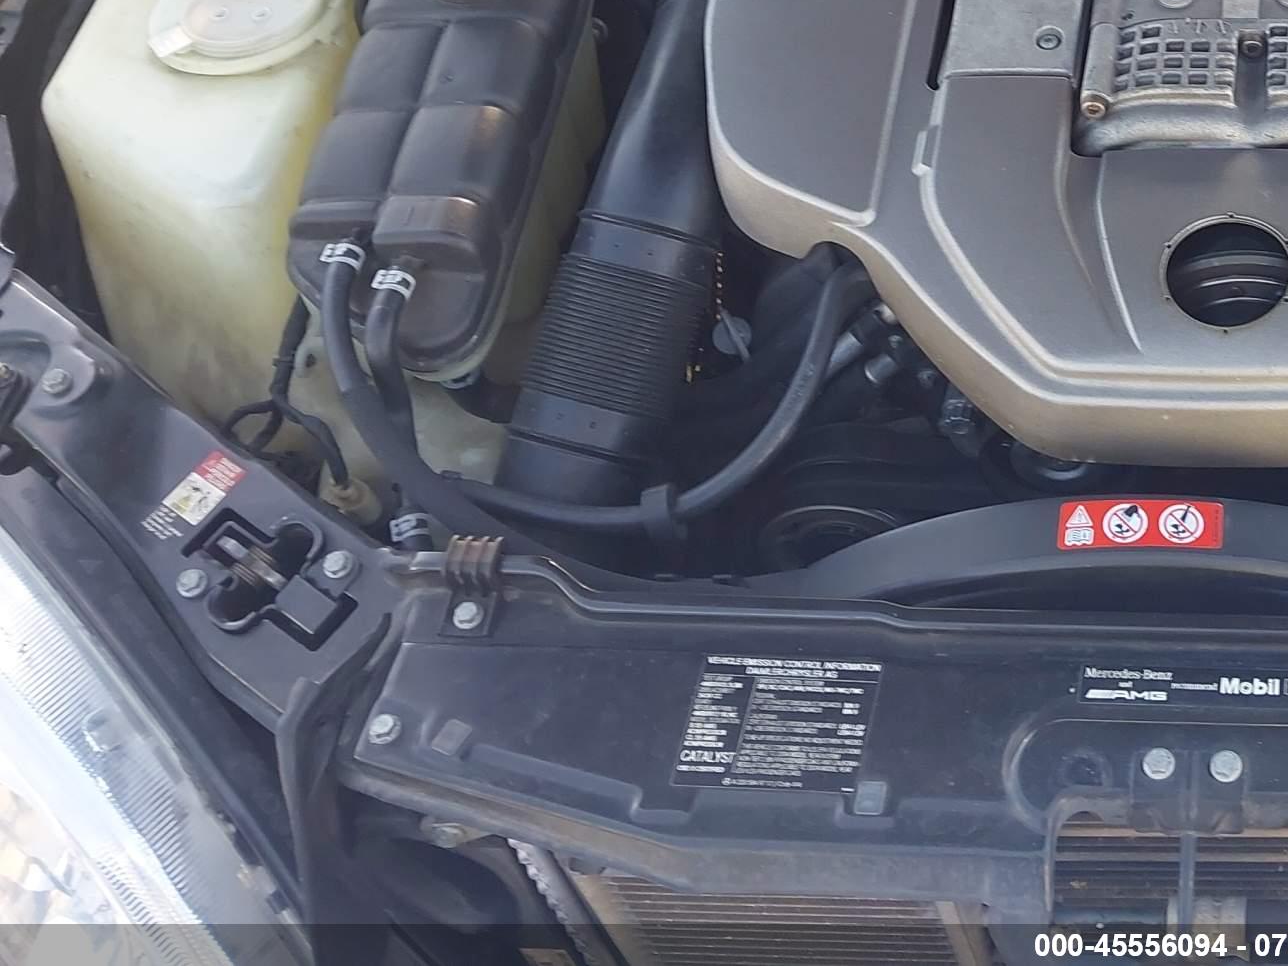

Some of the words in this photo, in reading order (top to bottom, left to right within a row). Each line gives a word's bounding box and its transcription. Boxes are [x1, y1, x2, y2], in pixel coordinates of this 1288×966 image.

[707, 656, 742, 666] VEHICLE
[742, 657, 783, 667] EMISSION
[784, 660, 822, 669] CONTROL
[822, 661, 882, 672] INFORMATION
[824, 670, 839, 679] AG
[1084, 666, 1173, 680] Mercedes-Benz
[1219, 677, 1281, 695] Mobil
[1108, 689, 1168, 701] AMG
[679, 749, 737, 764] CATALYST
